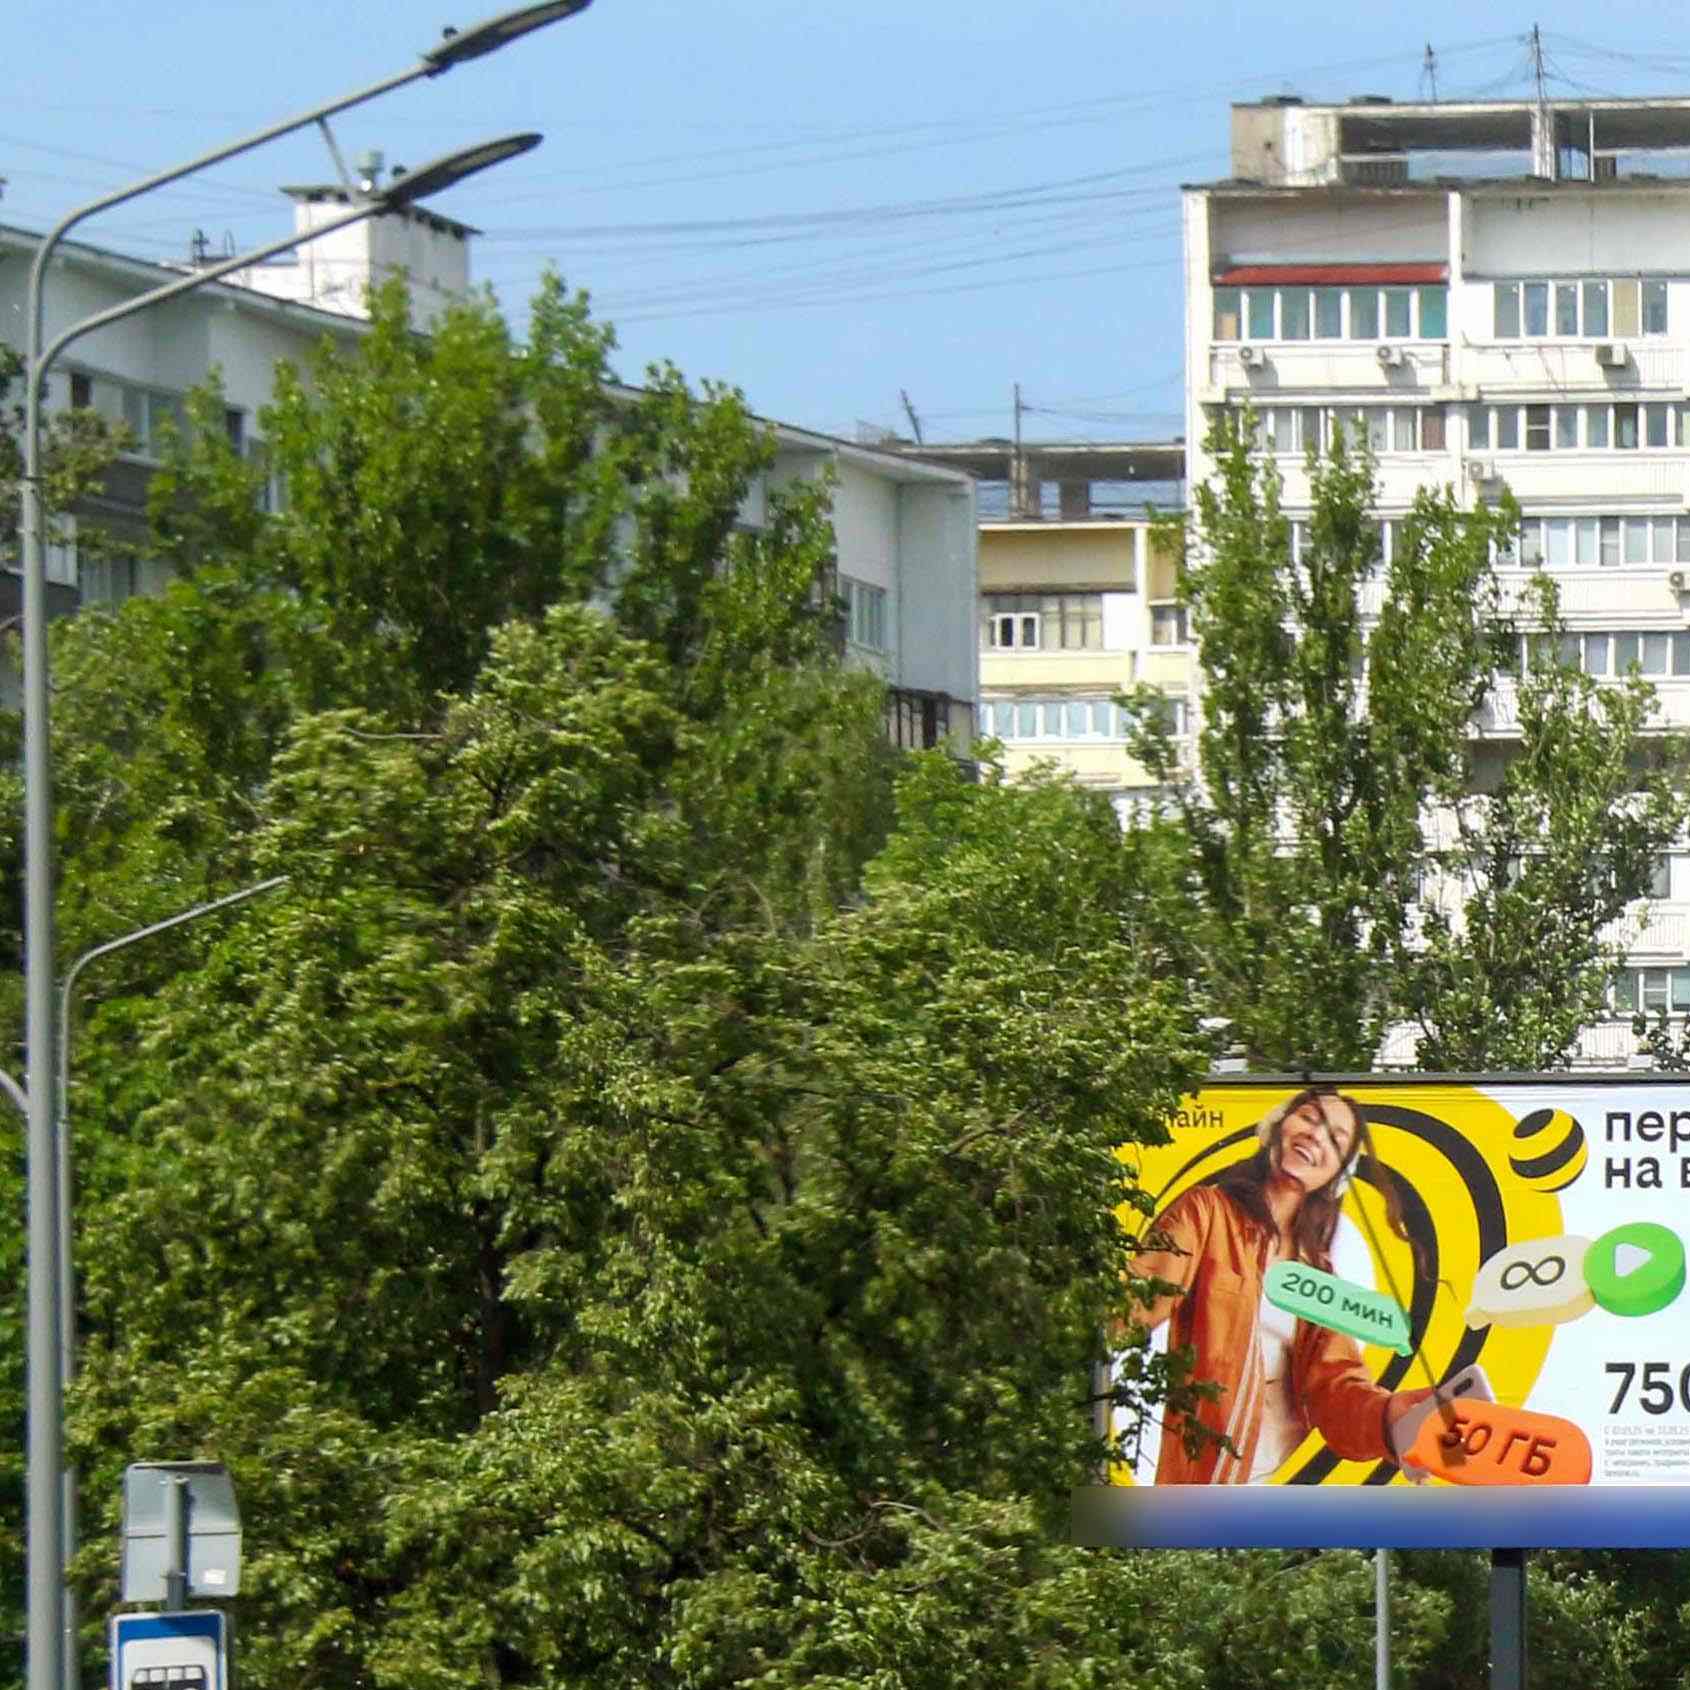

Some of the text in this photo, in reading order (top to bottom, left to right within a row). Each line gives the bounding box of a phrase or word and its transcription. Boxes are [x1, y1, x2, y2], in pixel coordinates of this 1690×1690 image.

[1604, 1156, 1663, 1189] на
[1281, 1272, 1394, 1330] 200 мин
[1496, 1428, 1558, 1477] ГБ
